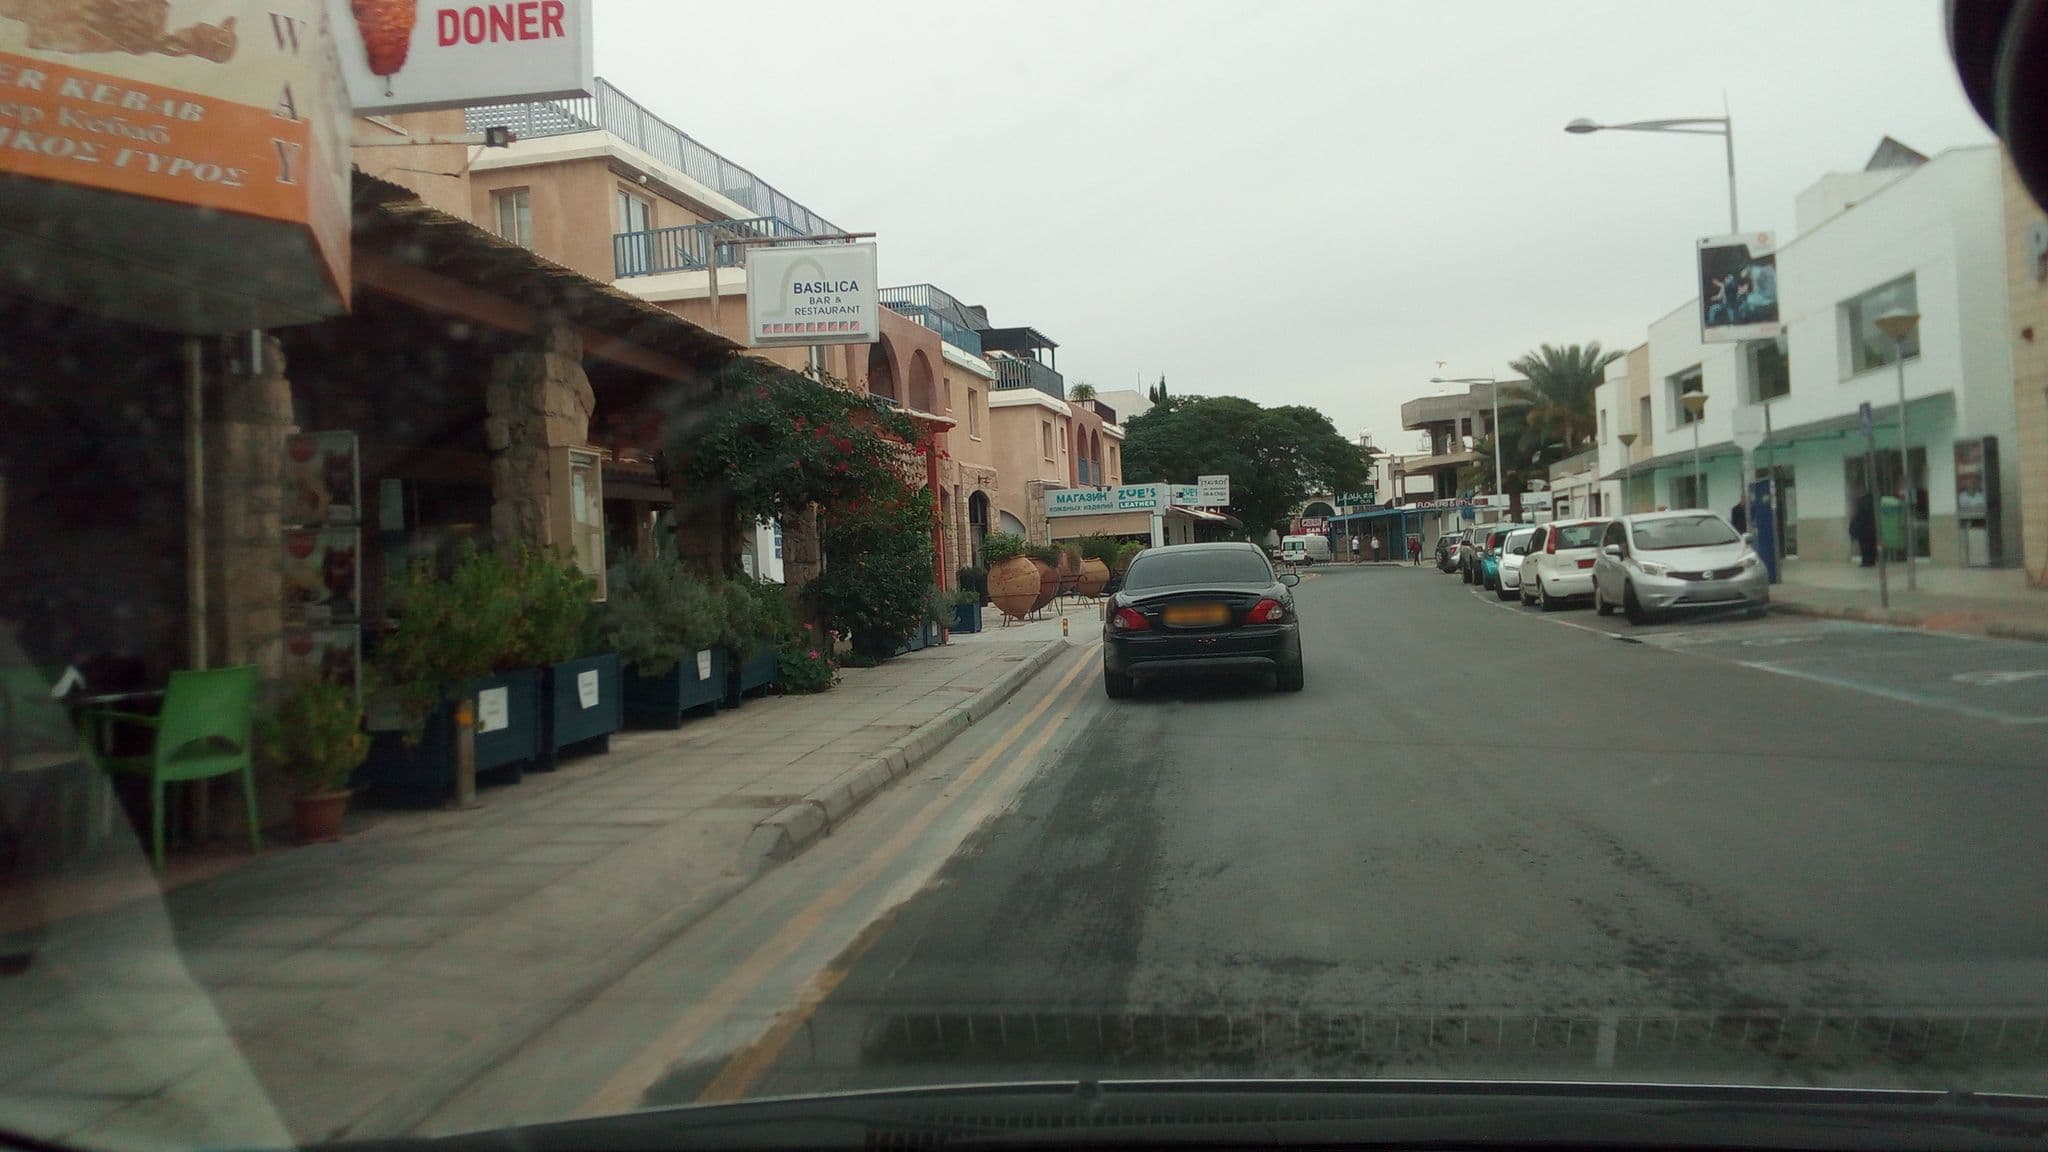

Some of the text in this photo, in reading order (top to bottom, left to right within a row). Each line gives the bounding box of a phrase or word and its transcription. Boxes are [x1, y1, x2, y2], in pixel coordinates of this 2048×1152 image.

[437, 1, 565, 47] DONER
[58, 76, 206, 122] KEBAB
[793, 280, 860, 294] BASILICA
[809, 296, 831, 305] BAR
[794, 305, 861, 316] RESTAURANT
[1056, 492, 1107, 503] МАГАЗИН
[1120, 501, 1155, 509] LEATHER
